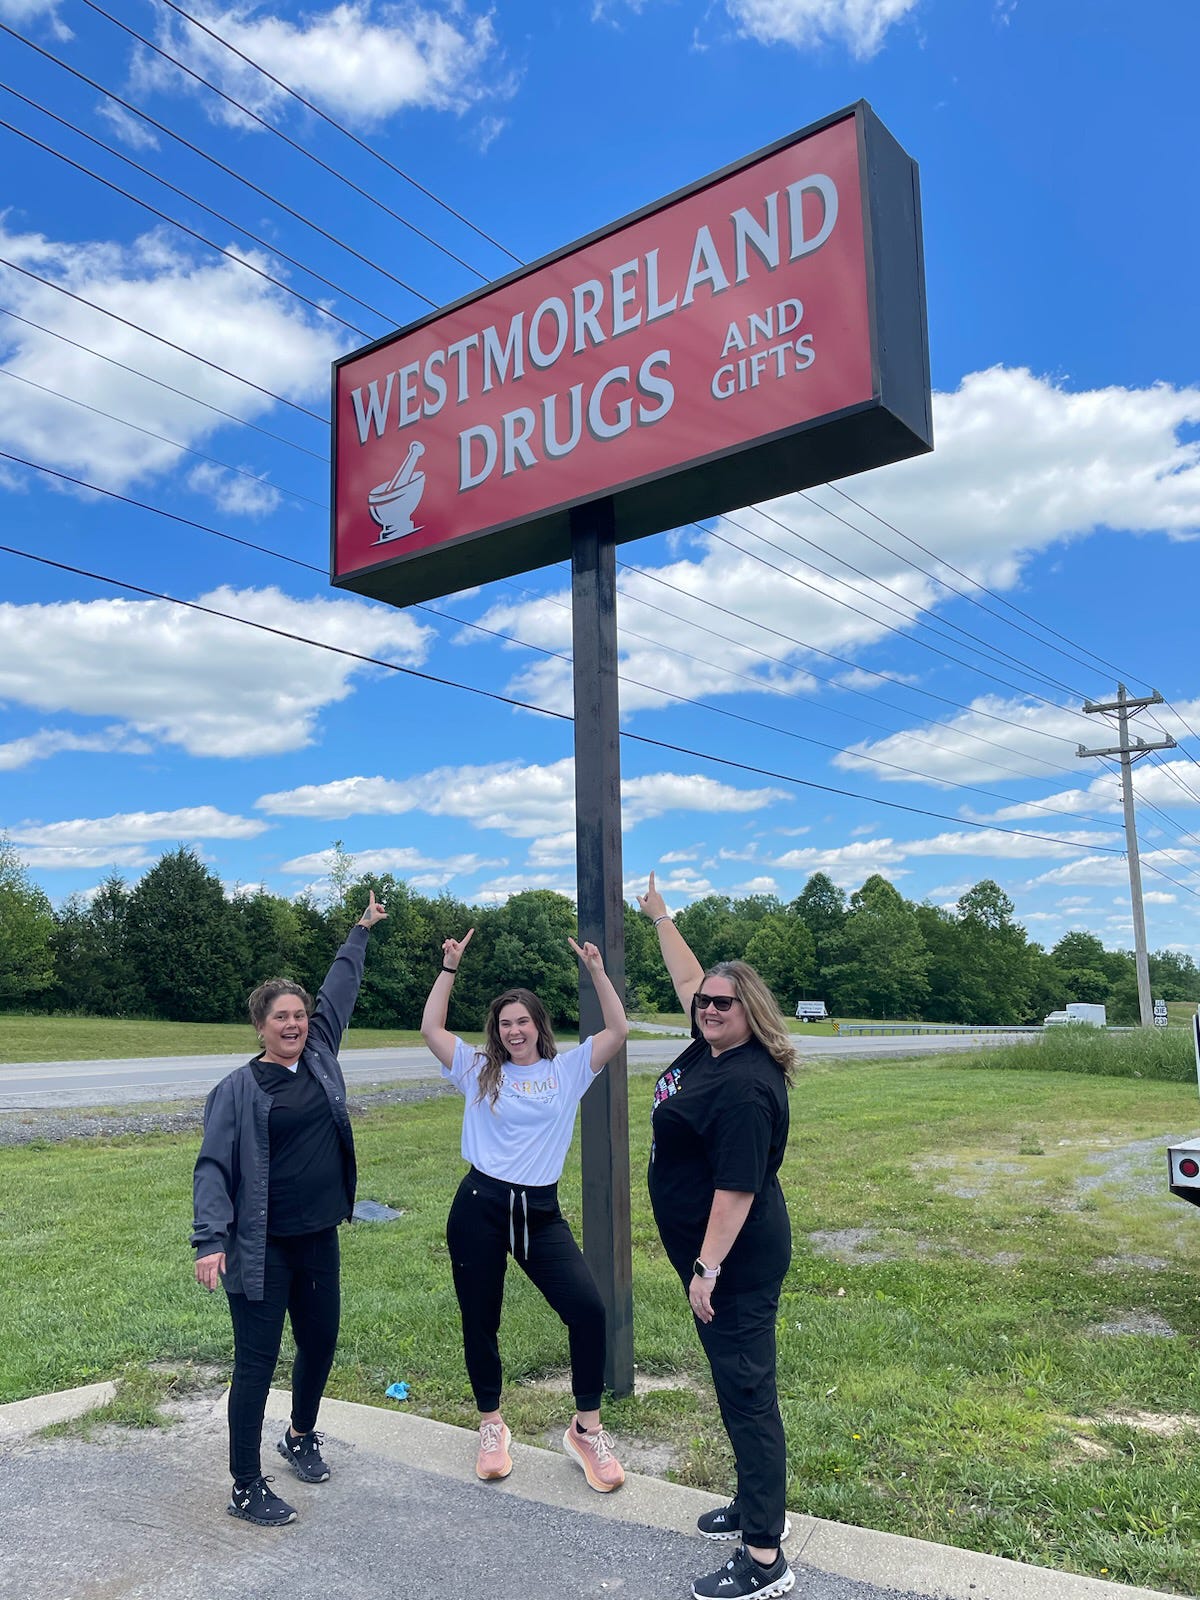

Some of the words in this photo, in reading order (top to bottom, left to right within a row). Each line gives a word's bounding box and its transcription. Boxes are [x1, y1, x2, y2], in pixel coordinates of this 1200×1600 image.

[351, 173, 839, 443] WESTMORELAND
[719, 297, 805, 358] AND
[710, 333, 816, 400] GIFTS
[457, 349, 676, 493] DRUGS
